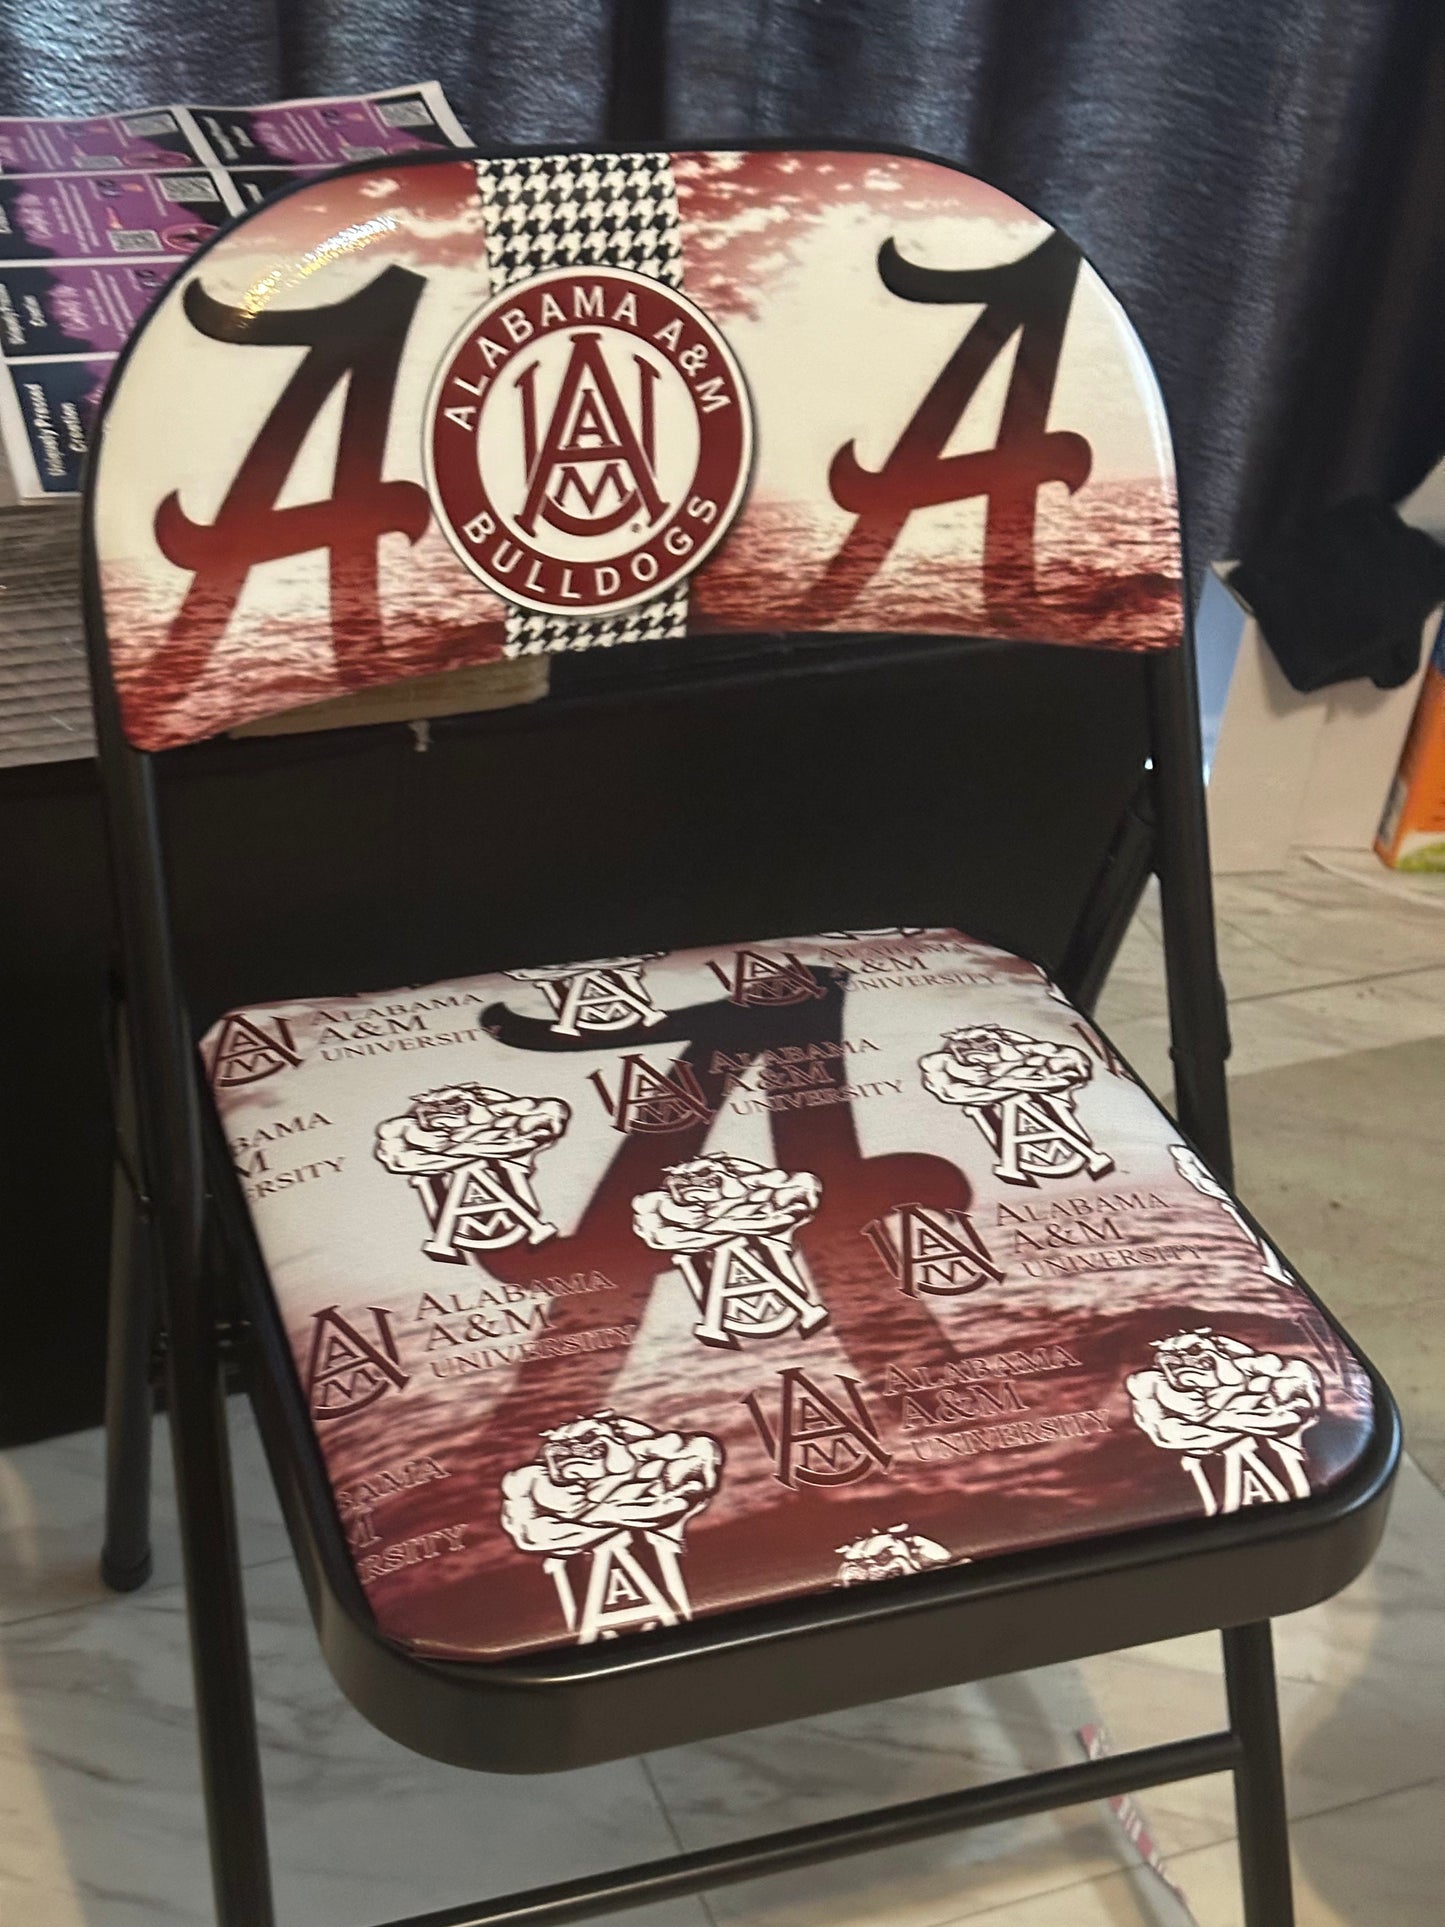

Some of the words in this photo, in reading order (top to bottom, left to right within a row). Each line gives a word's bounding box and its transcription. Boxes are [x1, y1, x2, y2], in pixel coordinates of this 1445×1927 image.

[444, 286, 638, 431] ALABAMA
[654, 318, 731, 413] A&M
[463, 496, 718, 599] BULLDOGS
[831, 956, 929, 977] A&M
[836, 971, 999, 993] UNIVERSITY
[310, 994, 484, 1026] ALABAMA
[320, 1015, 428, 1045] A&M
[708, 1037, 881, 1074] ALABAMA
[724, 1060, 837, 1096] A&M
[729, 1079, 905, 1117] UNIVERSITY
[996, 1193, 1170, 1226] ALABAMA
[1011, 1216, 1125, 1253] A&M
[1021, 1244, 1204, 1278] UNIVERSITY
[414, 1270, 618, 1321] ALABAMA
[426, 1303, 557, 1351] A&M
[430, 1324, 637, 1378] UNIVERSITY
[882, 1345, 1083, 1397] ALABAMA
[901, 1380, 1031, 1432] A&M
[910, 1409, 1113, 1462] UNIVERSITY
